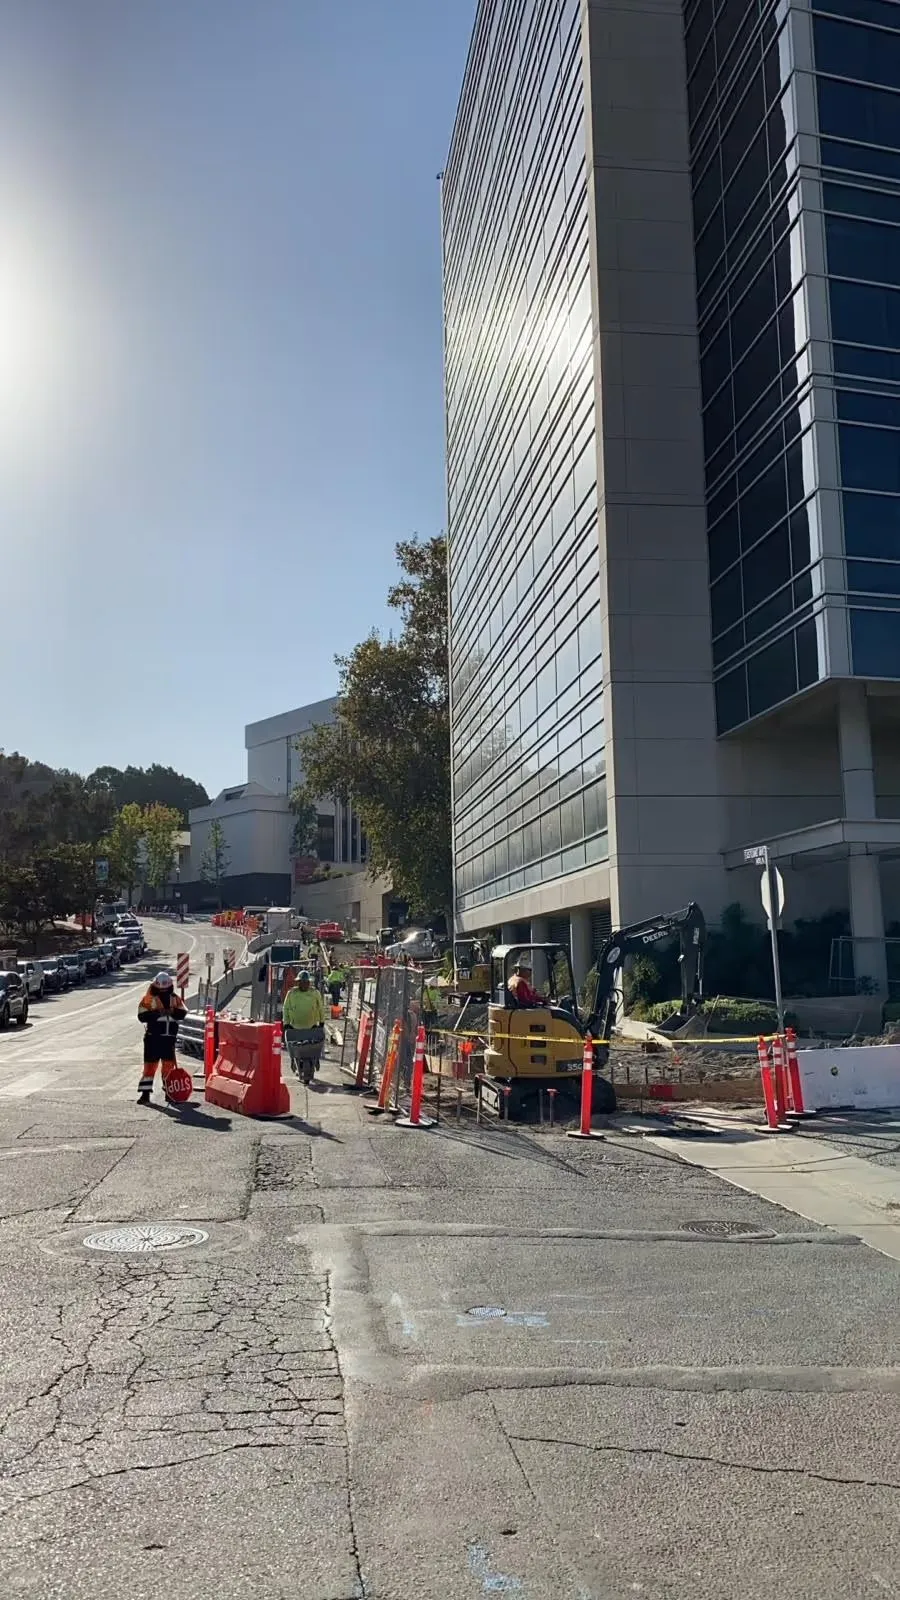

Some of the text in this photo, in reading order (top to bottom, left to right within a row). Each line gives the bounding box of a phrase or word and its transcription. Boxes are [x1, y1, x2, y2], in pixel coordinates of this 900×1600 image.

[642, 931, 668, 944] DEERE
[459, 970, 470, 980] CAT
[168, 1077, 191, 1093] STOP
